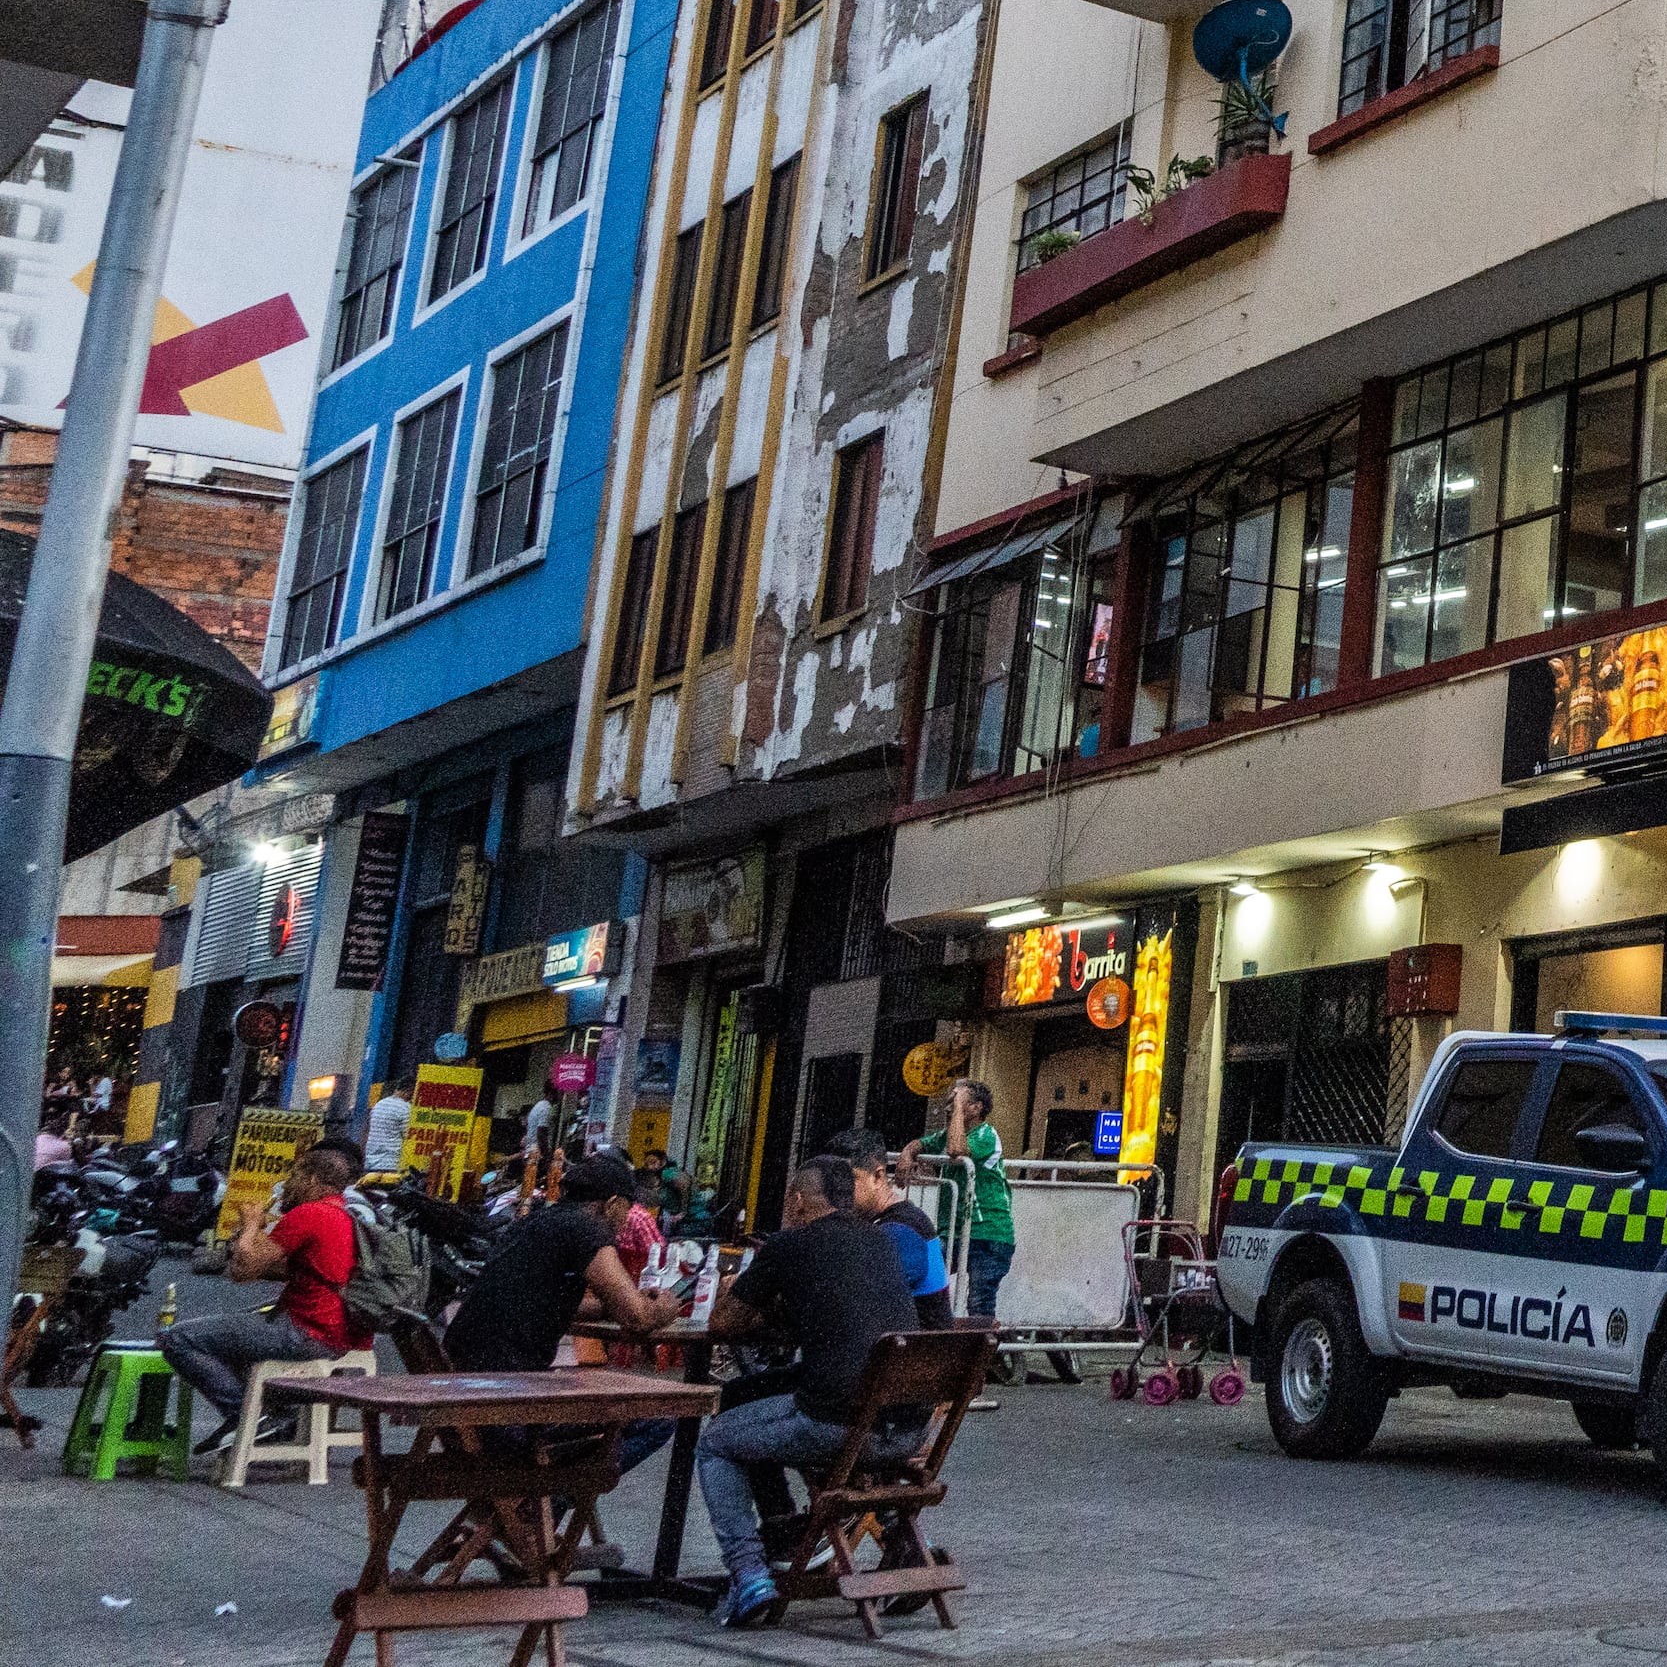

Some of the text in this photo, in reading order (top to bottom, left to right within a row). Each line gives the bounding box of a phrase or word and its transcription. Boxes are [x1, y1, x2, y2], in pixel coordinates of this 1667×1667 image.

[86, 660, 192, 717] ECK'S
[1102, 1135, 1121, 1143] CLU
[1104, 1119, 1121, 1127] HAI
[1429, 1285, 1596, 1348] POLICÍA
